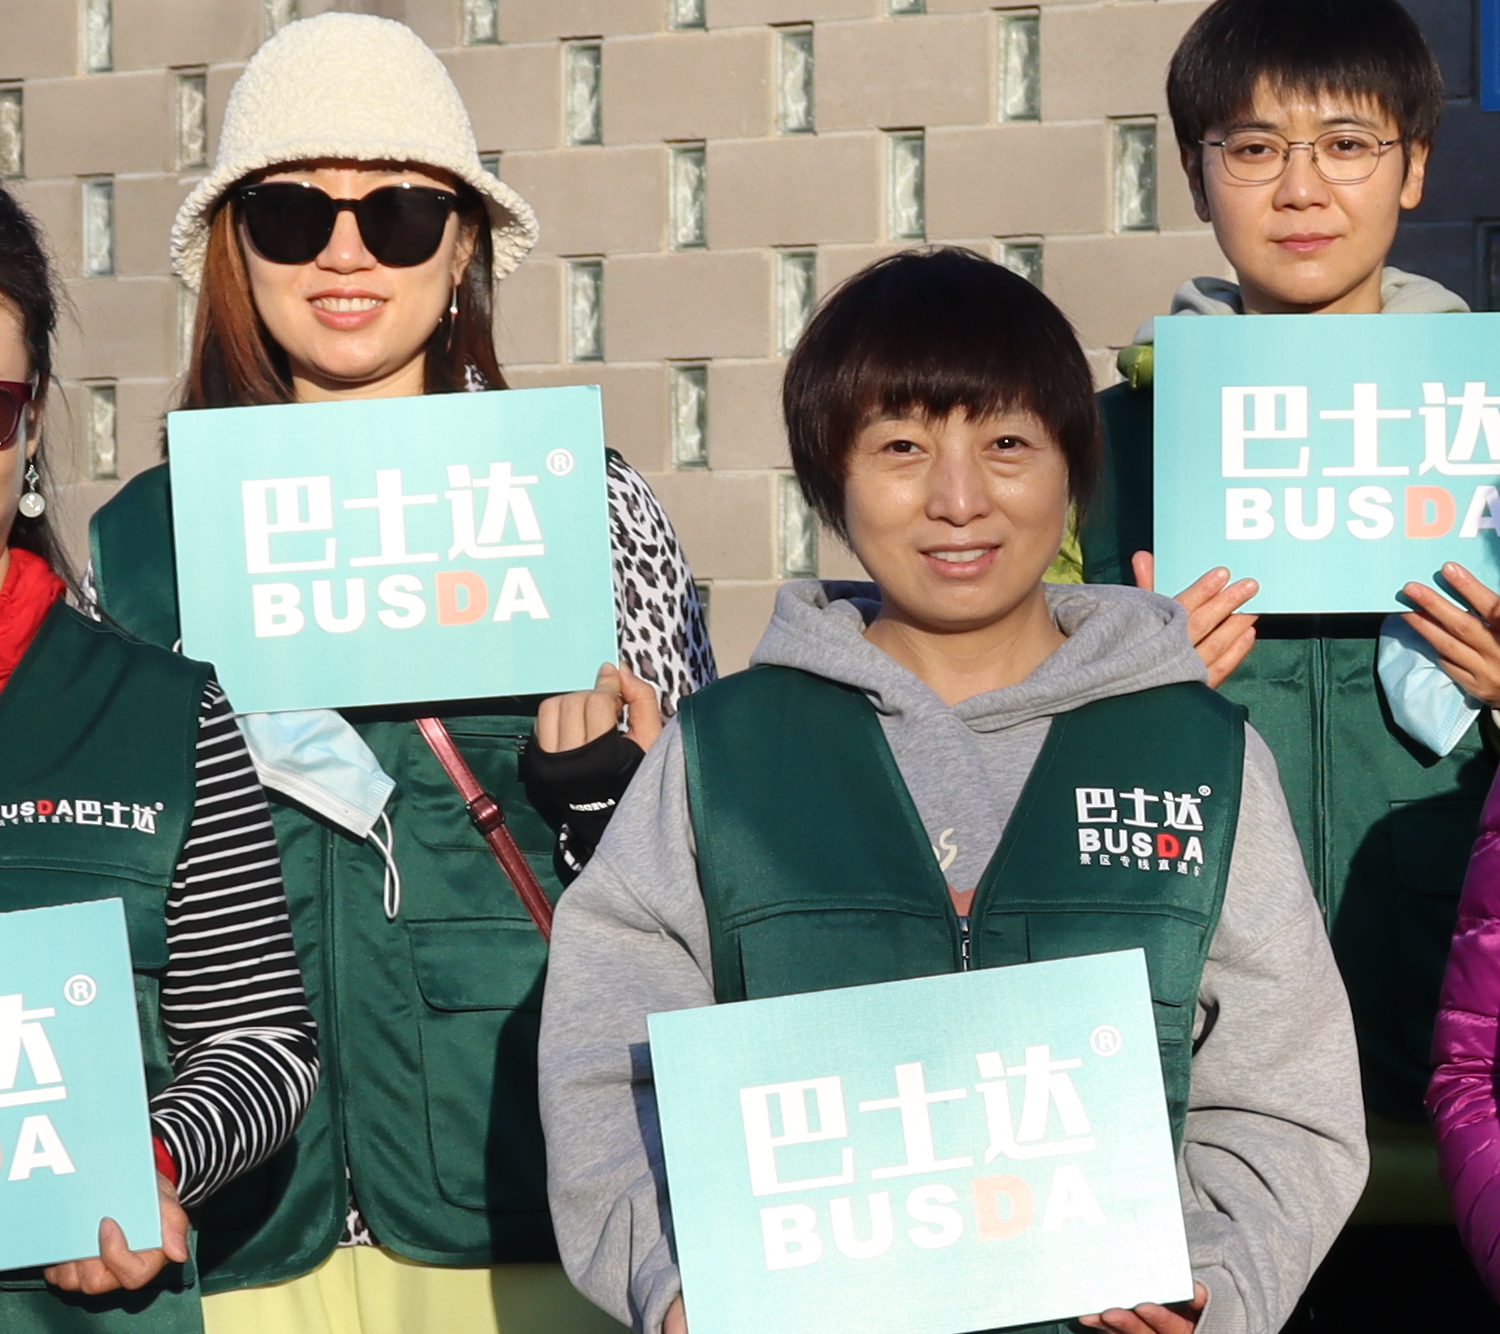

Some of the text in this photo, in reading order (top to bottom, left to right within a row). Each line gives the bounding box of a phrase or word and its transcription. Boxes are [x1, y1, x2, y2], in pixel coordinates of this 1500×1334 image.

[251, 567, 550, 638] BUSDA
[1078, 828, 1204, 865] BUSDA
[759, 1165, 1107, 1271] BUSDA
